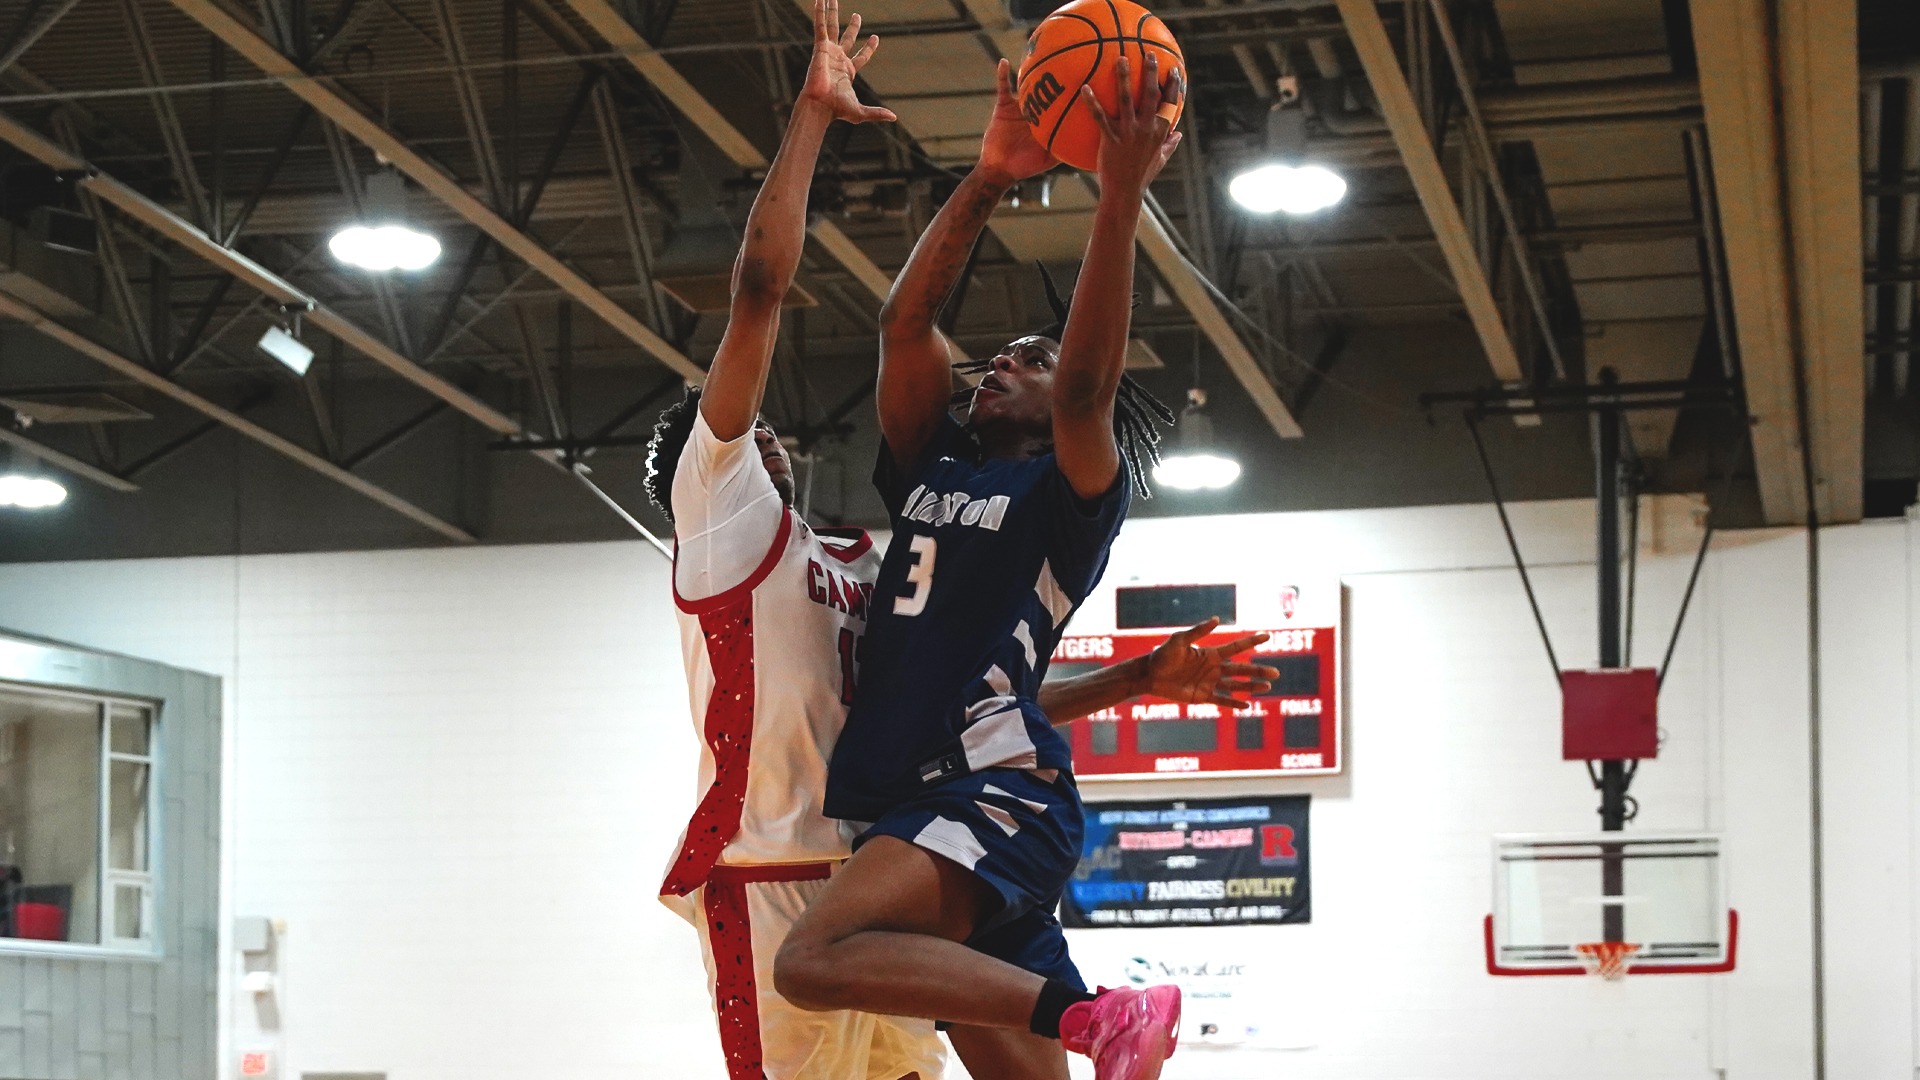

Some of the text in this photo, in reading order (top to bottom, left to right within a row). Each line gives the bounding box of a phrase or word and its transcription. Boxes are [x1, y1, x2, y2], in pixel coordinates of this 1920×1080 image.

[1023, 71, 1065, 127] Wil
[893, 534, 938, 617] 3
[808, 557, 874, 622] CAM
[1050, 638, 1114, 659] TGERS
[1131, 704, 1180, 719] PLAYER
[1280, 699, 1322, 715] FOULS
[946, 761, 952, 769] L
[1281, 754, 1322, 768] SCORE
[1261, 825, 1297, 858] R
[1148, 880, 1225, 901] FAIRNESS
[1226, 877, 1296, 898] CIVILITY
